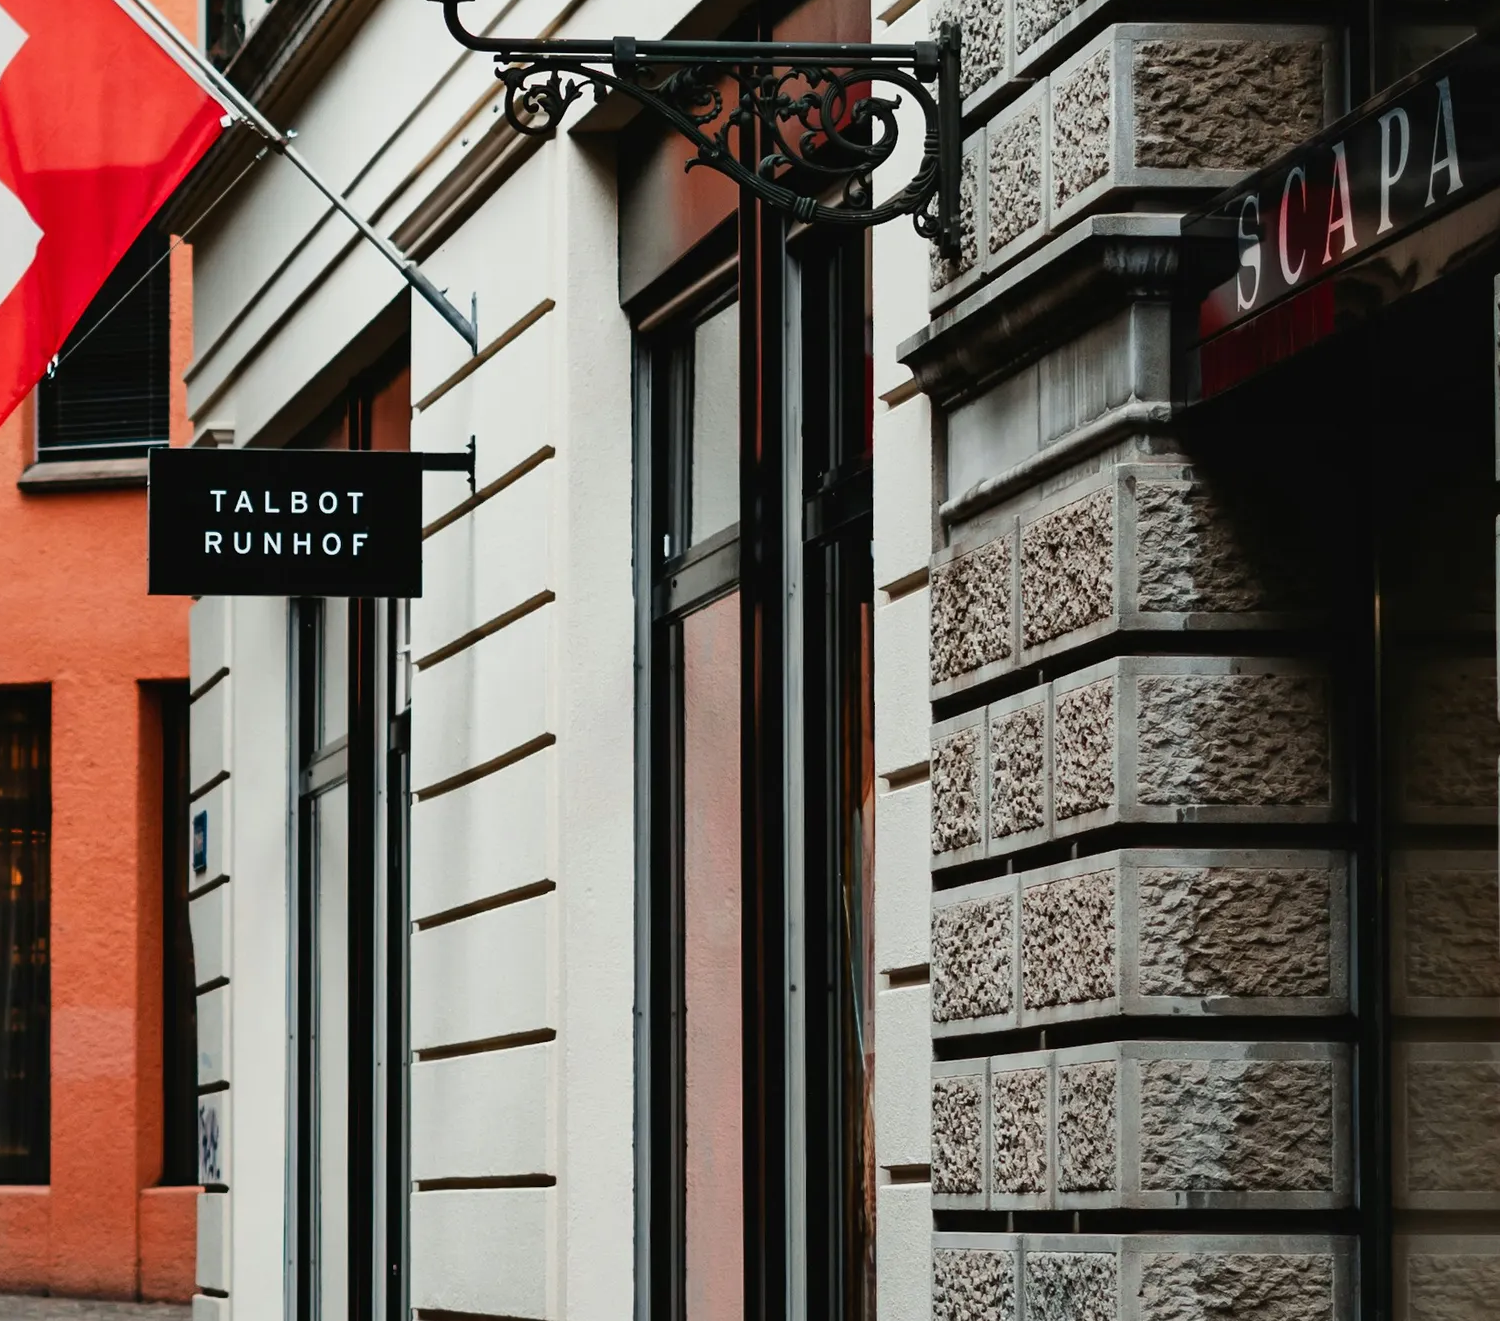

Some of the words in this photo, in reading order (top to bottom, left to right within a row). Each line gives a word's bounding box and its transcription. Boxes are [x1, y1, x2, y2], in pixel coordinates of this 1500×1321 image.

[1234, 76, 1464, 313] SCAPA
[209, 489, 365, 514] TALBOT
[204, 531, 369, 556] RUNHOF
